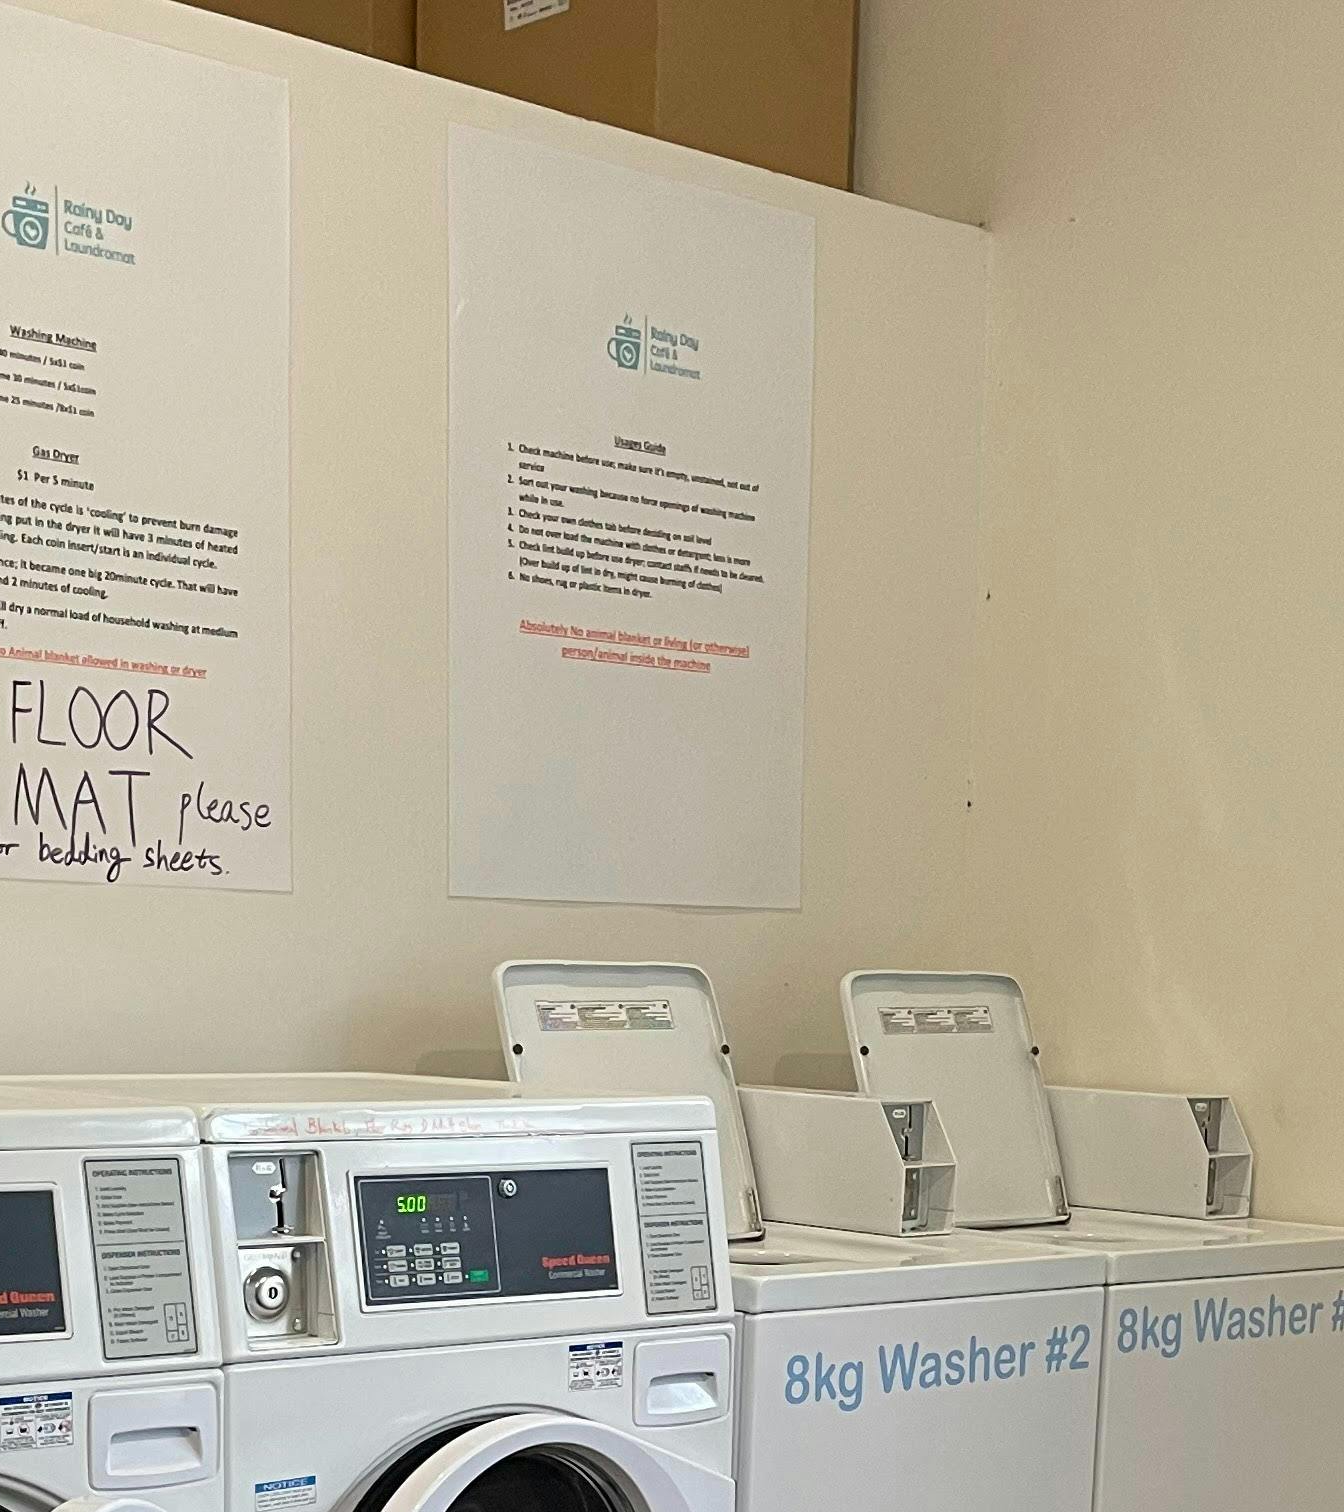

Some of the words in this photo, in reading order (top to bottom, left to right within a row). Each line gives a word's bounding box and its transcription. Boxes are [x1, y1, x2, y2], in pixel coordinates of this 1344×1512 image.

[64, 199, 103, 224] Rainy
[105, 208, 133, 231] Day
[64, 237, 137, 265] Laundromat
[10, 325, 54, 345] Washing
[54, 333, 97, 353] Machine
[32, 445, 51, 461] Gas
[17, 468, 28, 482] $1
[34, 471, 50, 484] Per
[61, 478, 94, 492] minute
[15, 516, 32, 527] put
[35, 516, 44, 529] in
[47, 518, 62, 531] the
[66, 520, 91, 536] dryer
[93, 524, 100, 536] it
[103, 527, 120, 539] will
[123, 529, 145, 542] have
[148, 532, 153, 544] 3
[156, 534, 192, 549] minutes
[195, 539, 205, 551] of
[207, 540, 238, 555] heated
[18, 496, 28, 508] of
[31, 497, 47, 511] the
[50, 502, 73, 515] cycle
[76, 504, 83, 516] is
[129, 513, 138, 524] to
[142, 516, 177, 529] prevent
[180, 519, 200, 533] burn
[203, 523, 238, 540] damage
[21, 532, 43, 546] Each
[46, 537, 65, 549] coin
[68, 539, 120, 555] insert/start
[123, 547, 131, 557] is
[133, 550, 144, 559] an
[146, 549, 190, 566] individual
[193, 557, 217, 570] cycle.
[12, 576, 17, 587] 2
[20, 577, 58, 592] minutes
[61, 582, 70, 594] of
[73, 586, 108, 600] cooling.
[9, 601, 24, 616] dry
[27, 605, 32, 615] a
[34, 606, 67, 619] normal
[70, 608, 89, 621] load
[92, 612, 101, 623] of
[103, 612, 150, 629] household
[152, 621, 189, 636] washing
[191, 625, 200, 634] at
[202, 627, 238, 639] medium
[11, 679, 194, 760] FLOOR
[14, 762, 151, 848] MAT
[177, 781, 273, 845] please
[38, 831, 132, 883] bedding
[9, 1290, 55, 1304] Queen
[20, 1307, 49, 1318] Washer
[1117, 1307, 1182, 1358] 8kg
[1194, 1296, 1324, 1343] Washer
[785, 1353, 864, 1412] 8kg
[878, 1336, 1037, 1393] Washer
[1046, 1323, 1091, 1374] #2
